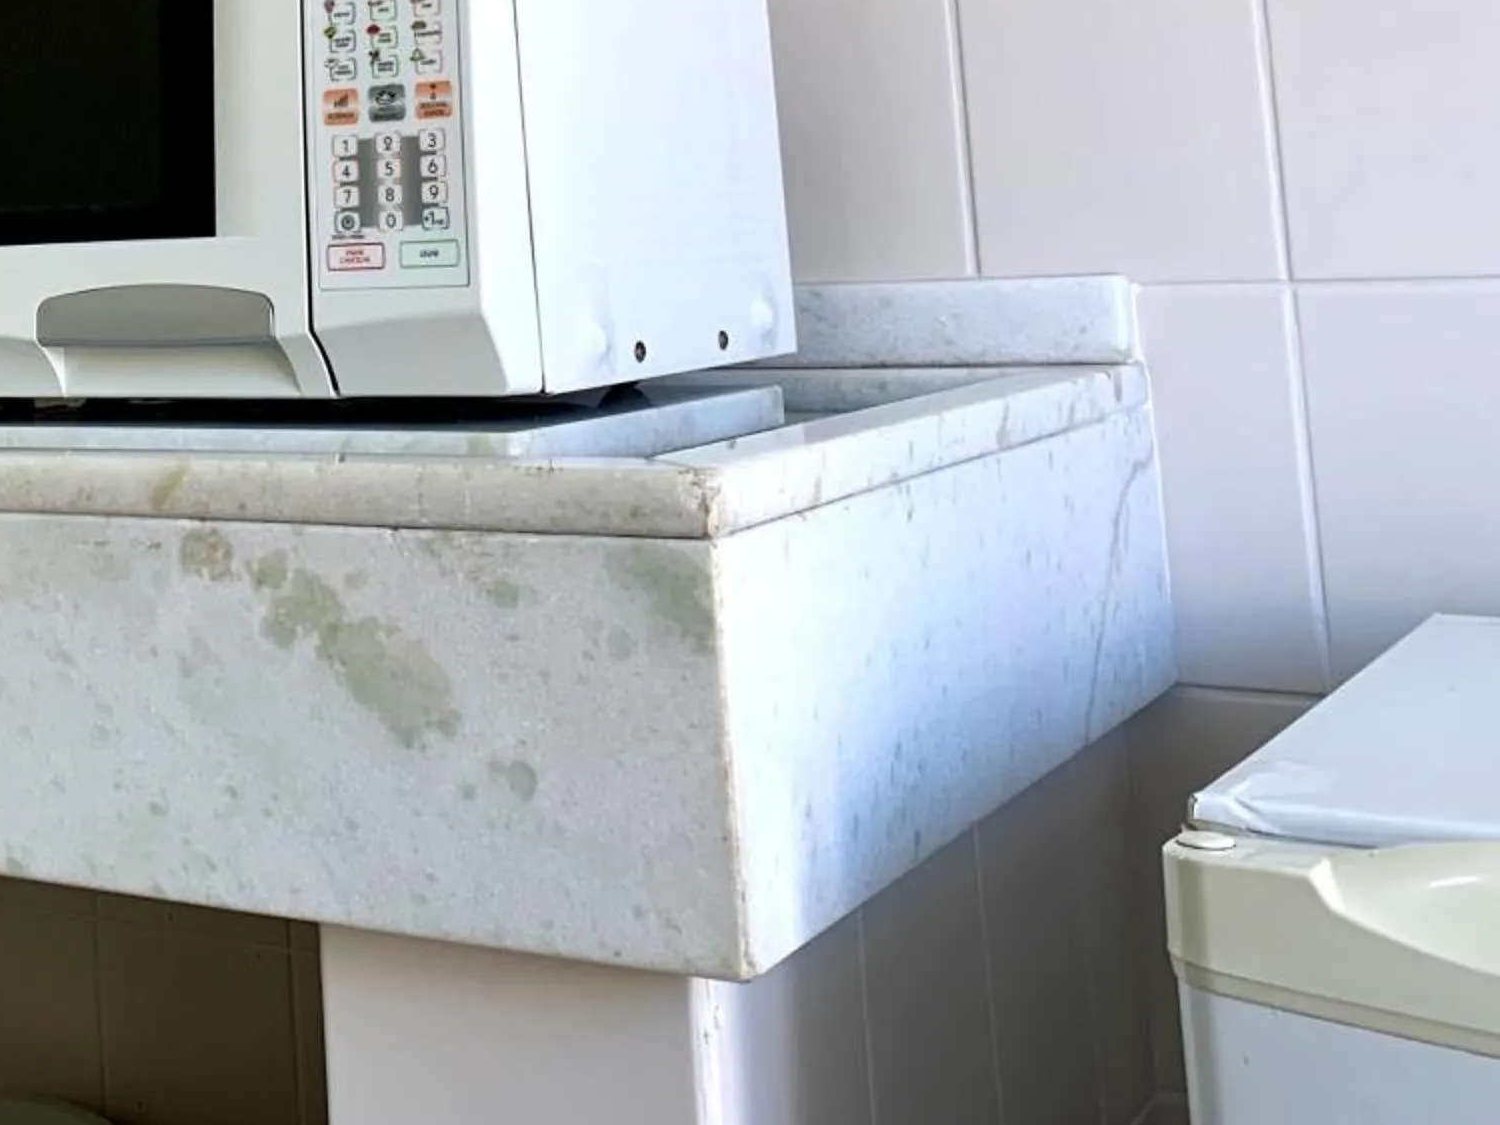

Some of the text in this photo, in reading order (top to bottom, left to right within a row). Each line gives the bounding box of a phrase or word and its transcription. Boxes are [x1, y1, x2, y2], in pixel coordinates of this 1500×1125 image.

[341, 139, 349, 153] 1
[383, 135, 393, 151] 2
[427, 132, 437, 148] 3
[342, 164, 351, 178] 4
[385, 161, 394, 177] 5
[427, 158, 438, 174] 6
[342, 189, 352, 204] 7
[385, 187, 395, 203] 8
[428, 185, 439, 200] 9
[385, 213, 397, 229] 0
